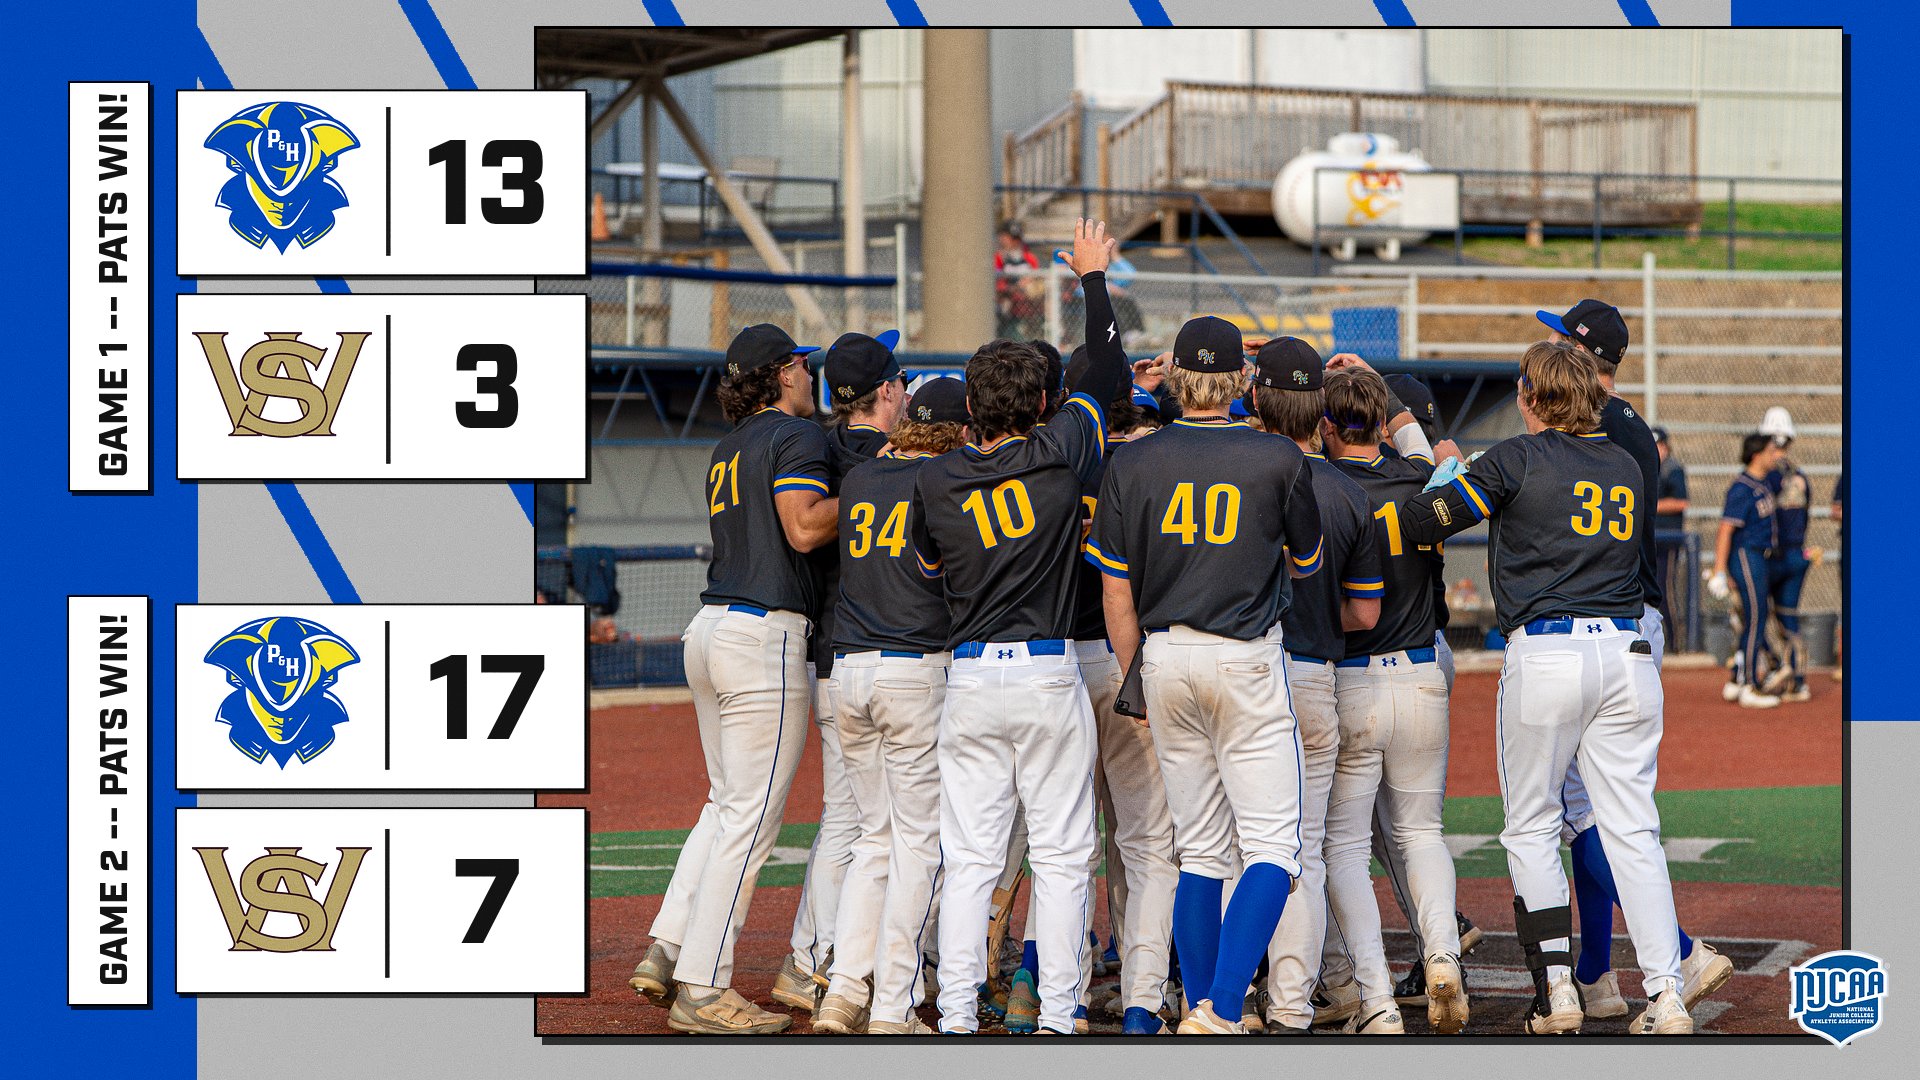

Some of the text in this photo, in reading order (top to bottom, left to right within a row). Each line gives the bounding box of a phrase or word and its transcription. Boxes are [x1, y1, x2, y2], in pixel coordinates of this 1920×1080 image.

[710, 450, 741, 518] 21
[961, 478, 1036, 549] 10
[1160, 481, 1242, 546] 40
[1570, 481, 1636, 542] 33
[848, 500, 910, 559] 34
